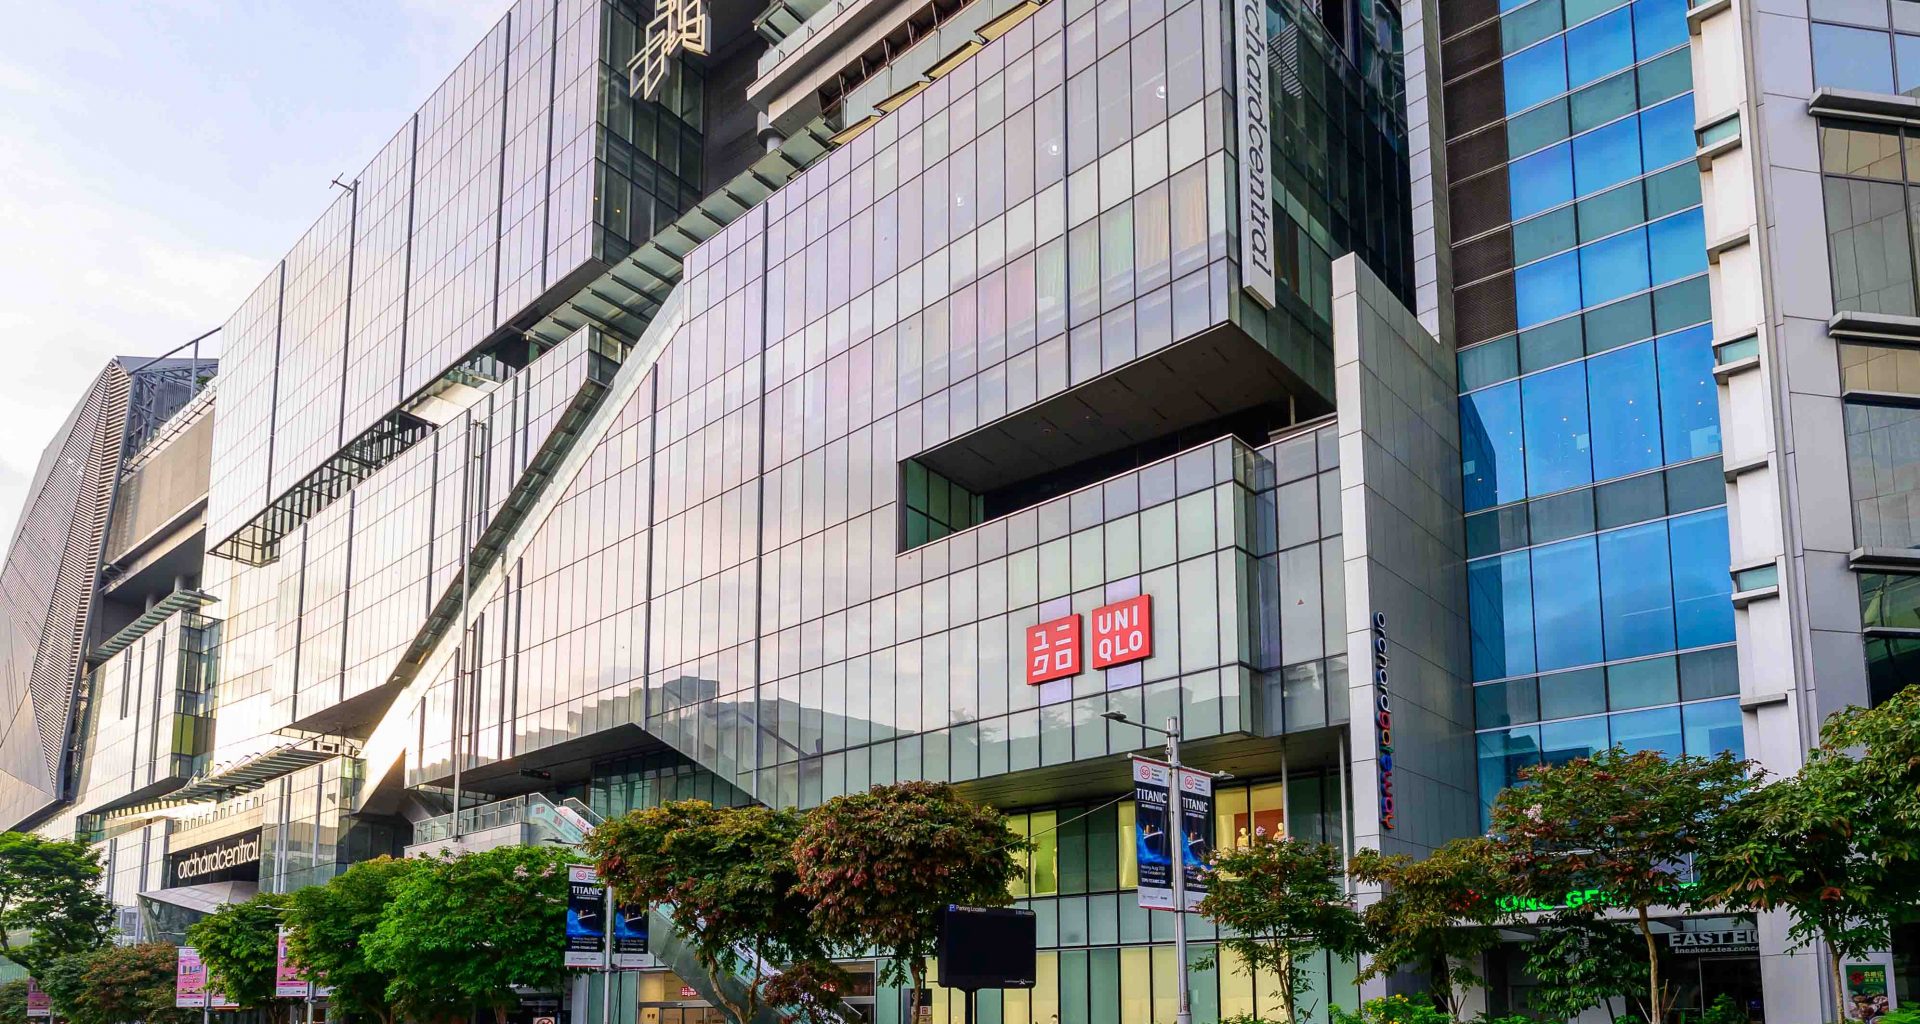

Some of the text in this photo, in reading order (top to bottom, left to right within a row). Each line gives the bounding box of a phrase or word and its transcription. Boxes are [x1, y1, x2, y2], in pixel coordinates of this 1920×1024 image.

[1098, 605, 1138, 634] UNI
[1098, 630, 1143, 661] QLO
[1374, 612, 1395, 829] orchardgateway
[1136, 788, 1167, 803] TITANIC
[1182, 797, 1208, 812] TITANIC
[178, 834, 259, 879] orchardcentral
[572, 886, 603, 896] TITANIC
[1668, 931, 1728, 947] EAST
